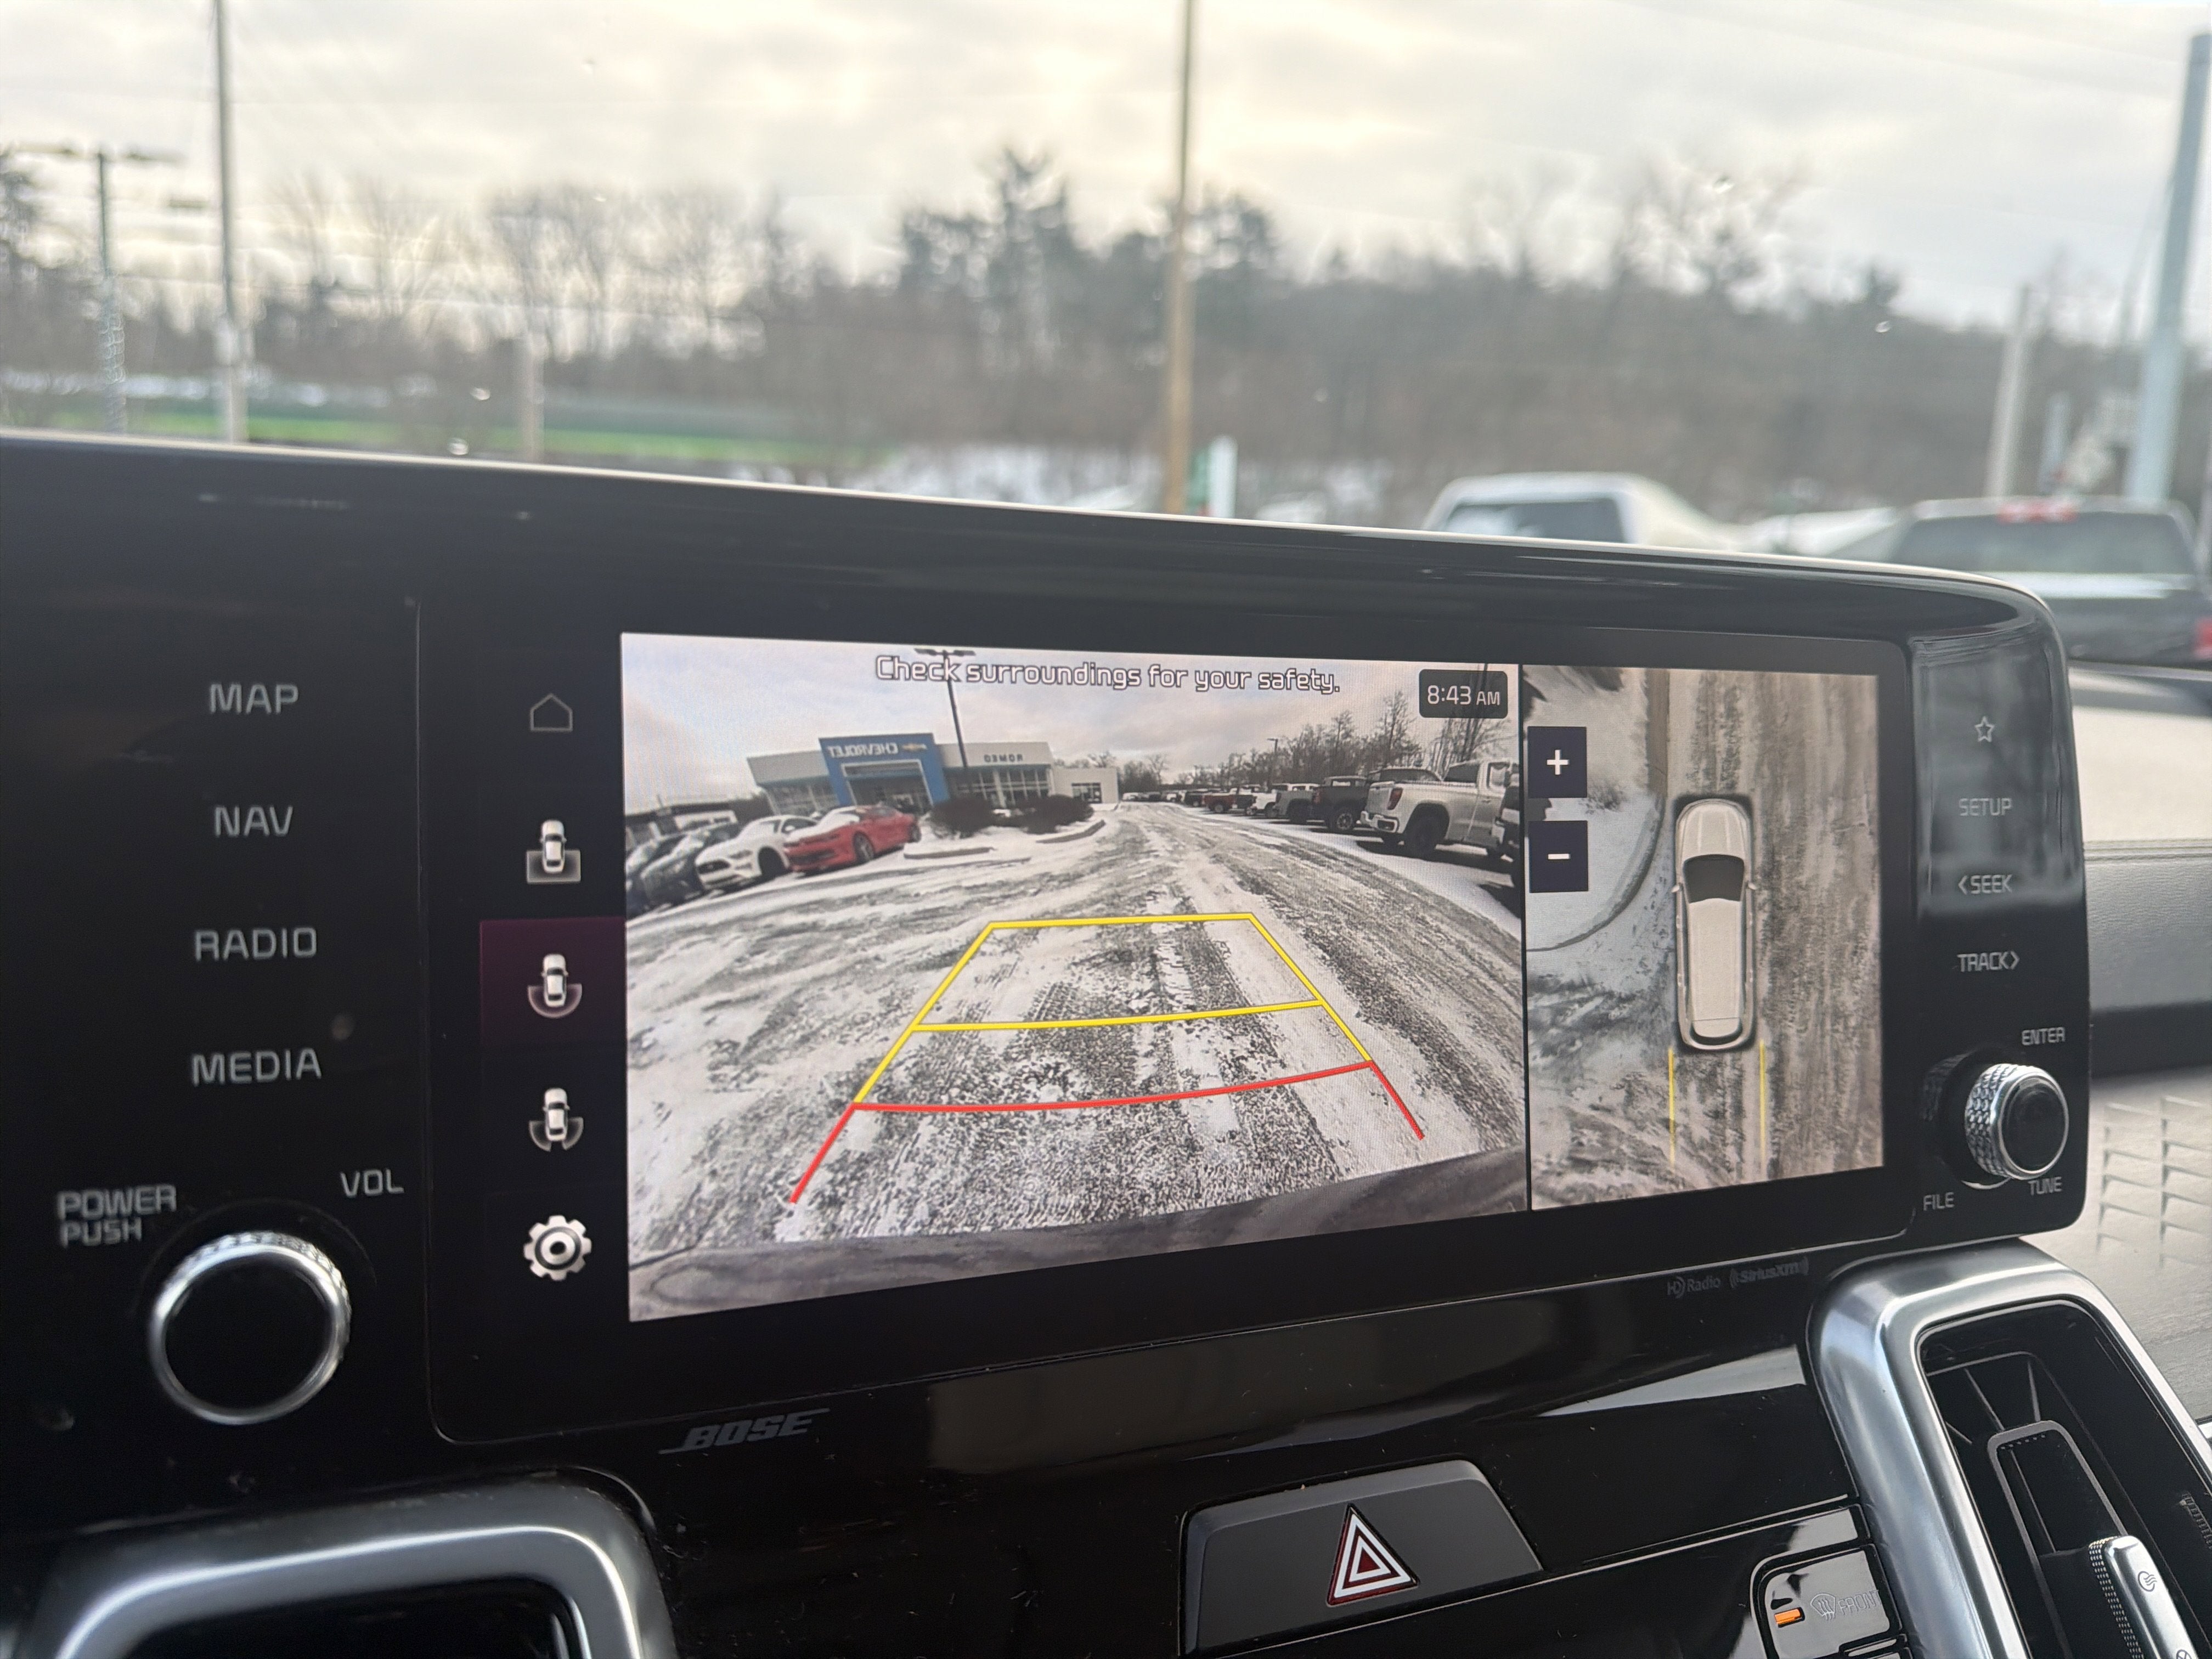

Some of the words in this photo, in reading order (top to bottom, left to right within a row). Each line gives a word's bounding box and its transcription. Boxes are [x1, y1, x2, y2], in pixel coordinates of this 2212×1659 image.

[876, 655, 961, 682] Check
[966, 662, 1141, 690] surroundings
[1148, 664, 1188, 688] for
[1194, 669, 1251, 692] your
[1259, 668, 1340, 695] safety.
[208, 682, 299, 714] MAP
[1427, 685, 1471, 705] 8:43
[1476, 691, 1500, 706] AM
[213, 805, 294, 837] NAV
[1959, 797, 2013, 816] SETUP
[194, 926, 318, 962] RADIO
[2021, 1026, 2066, 1046] ENTER
[191, 1047, 323, 1087] MEDIA
[340, 1168, 405, 1198] VOL
[2028, 1177, 2062, 1195] TUNE
[56, 1184, 177, 1220] POWER
[1923, 1192, 1955, 1211] FILE
[59, 1217, 143, 1248] PUSH
[1686, 1276, 1721, 1293] Radio
[658, 1407, 830, 1455] BOSE
[1838, 1589, 1882, 1615] FRONT
